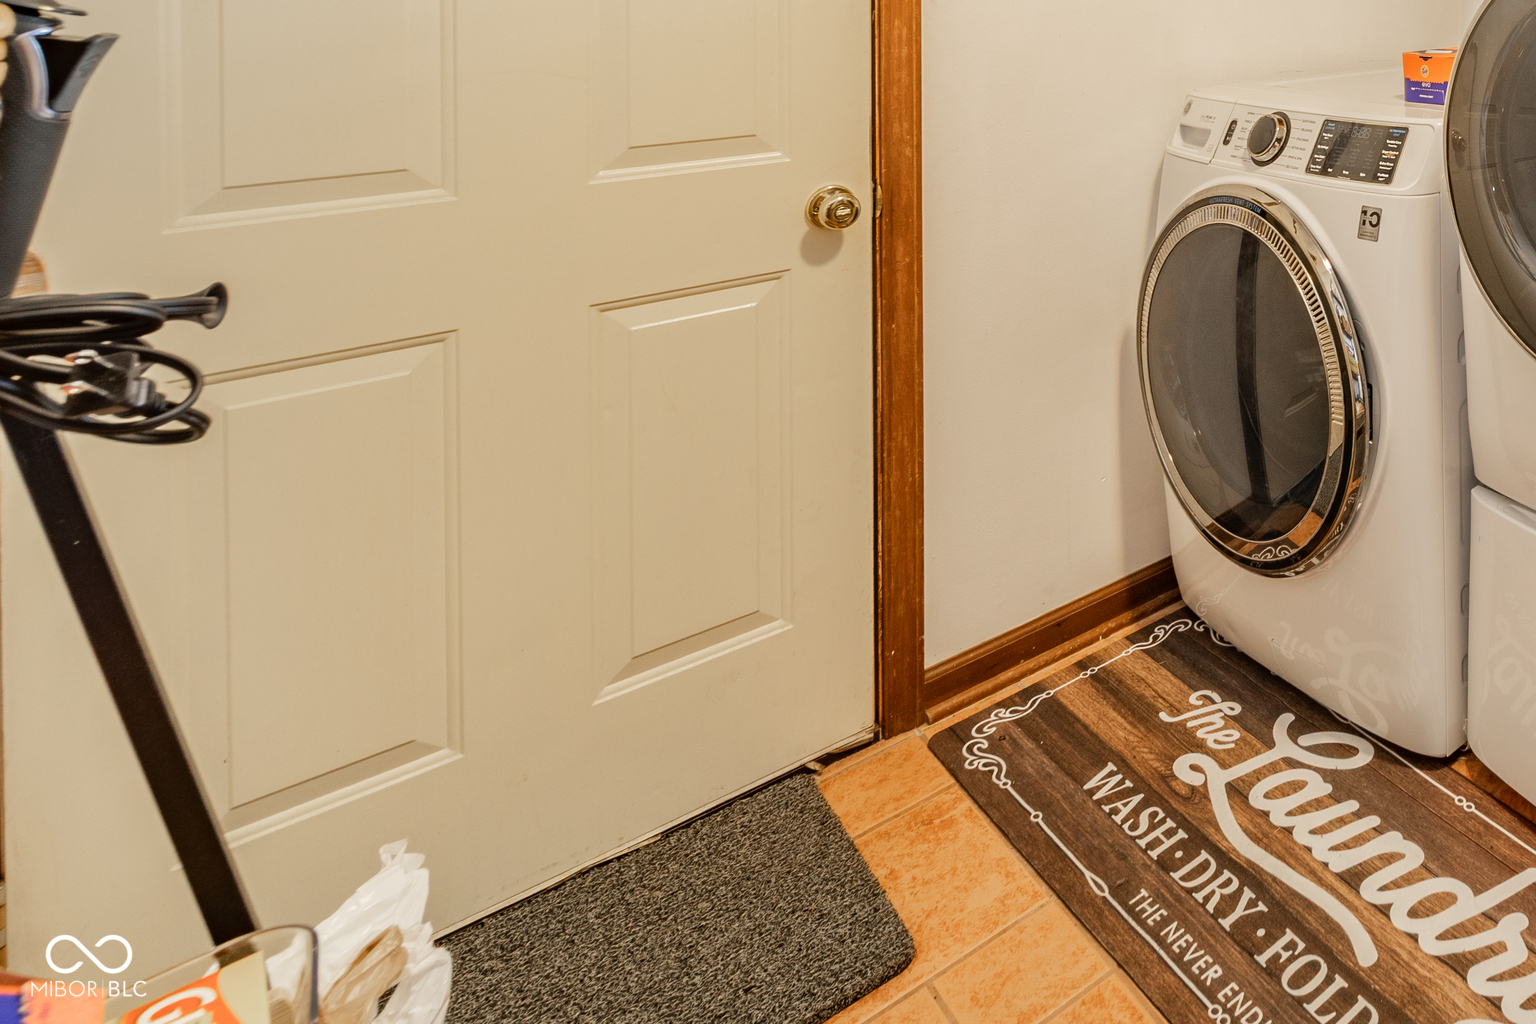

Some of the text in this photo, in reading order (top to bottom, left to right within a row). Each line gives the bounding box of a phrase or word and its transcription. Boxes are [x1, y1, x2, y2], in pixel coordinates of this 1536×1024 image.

[1234, 197, 1245, 206] VENT
[1361, 209, 1381, 228] 10
[1159, 689, 1243, 750] The
[1081, 760, 1379, 1024] WASH DRY FOLD
[1127, 889, 1161, 926] THE
[1160, 921, 1223, 986] NEVER
